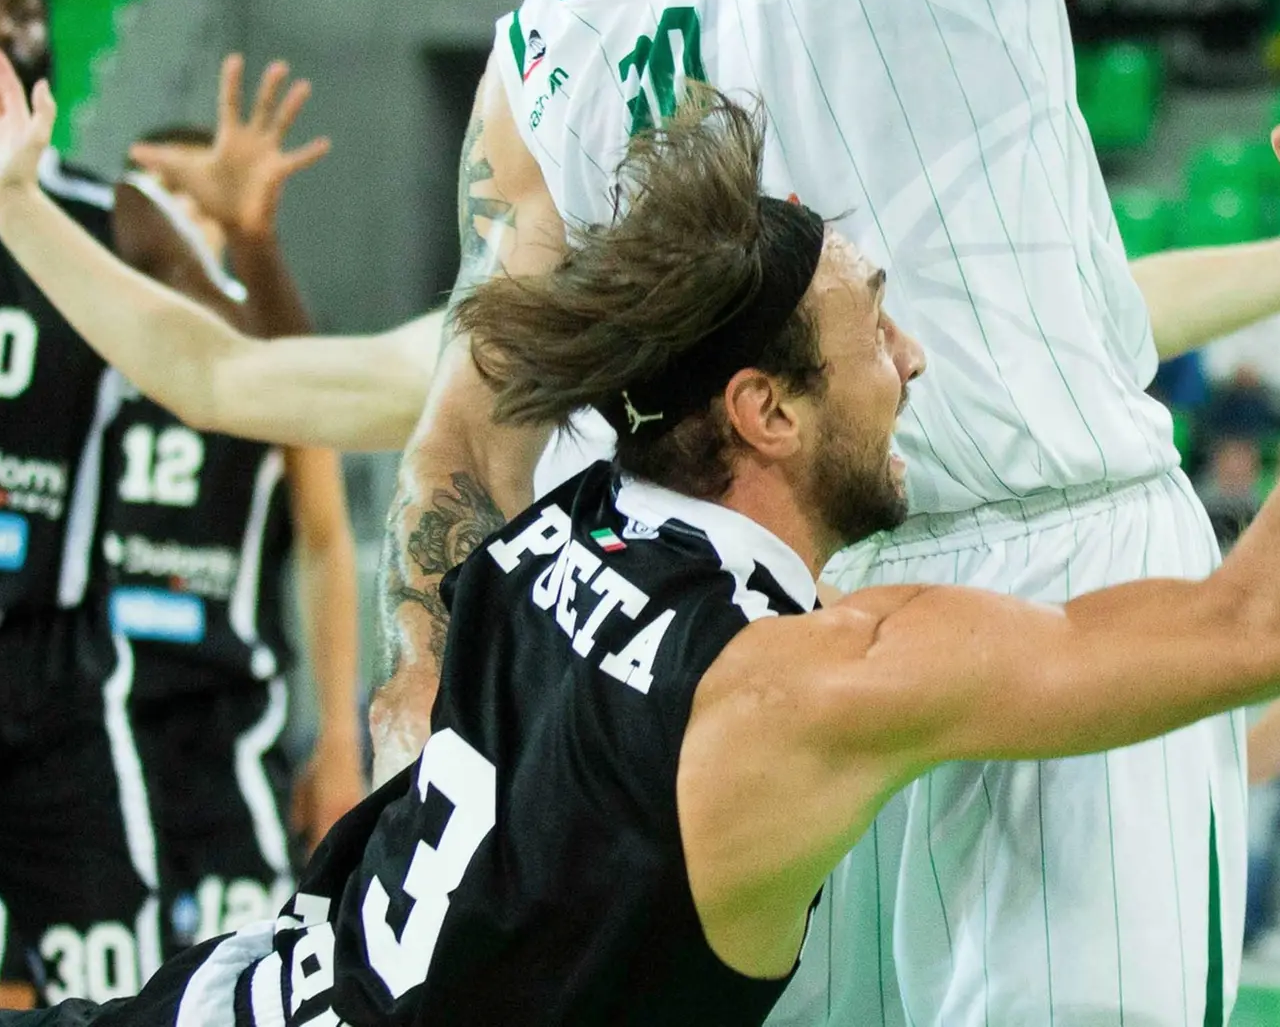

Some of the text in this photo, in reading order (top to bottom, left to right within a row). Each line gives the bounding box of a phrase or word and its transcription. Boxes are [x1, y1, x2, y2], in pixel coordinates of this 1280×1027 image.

[120, 426, 205, 506] 12
[487, 503, 677, 695] POETA
[363, 727, 497, 1000] 3
[40, 919, 138, 1007] 30
